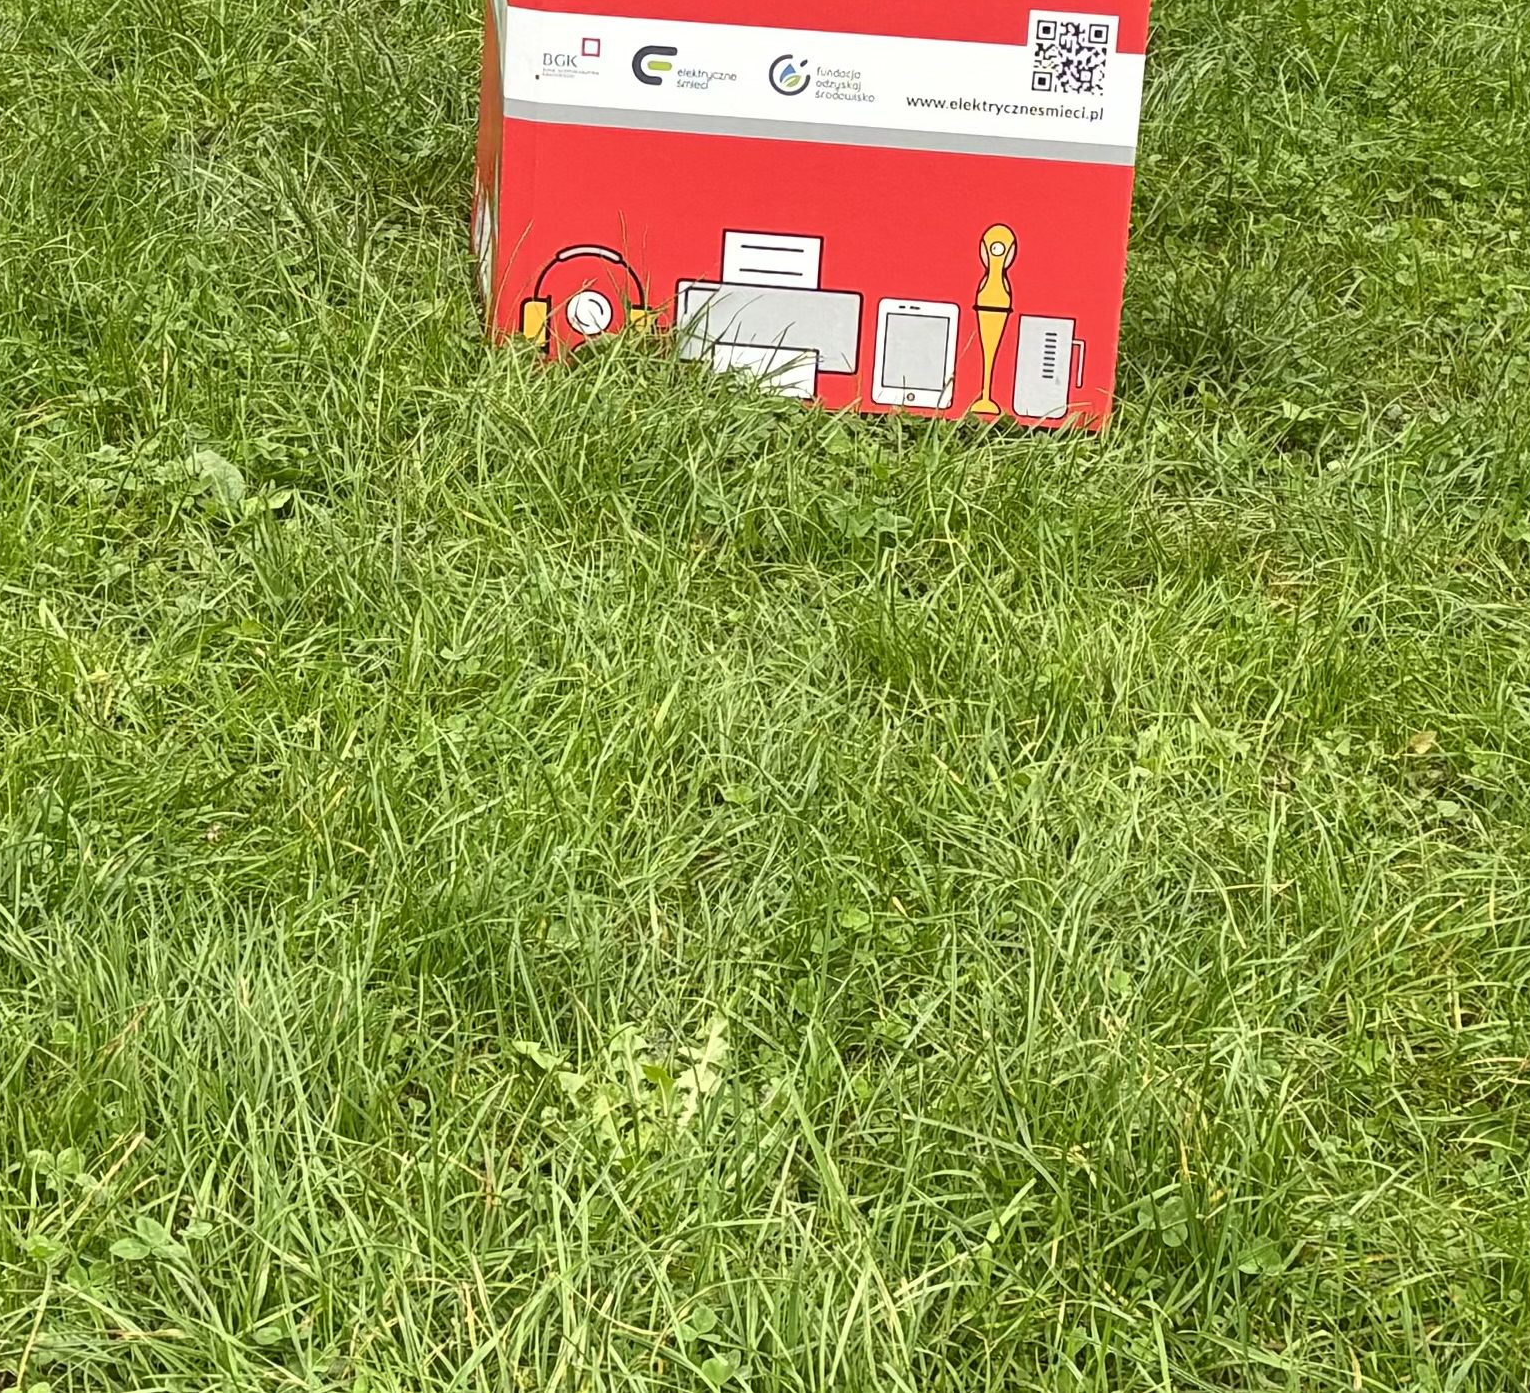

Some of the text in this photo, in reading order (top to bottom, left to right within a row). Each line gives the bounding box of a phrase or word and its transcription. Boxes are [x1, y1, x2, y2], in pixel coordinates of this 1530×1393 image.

[542, 52, 578, 68] BGK
[816, 66, 861, 81] fundacja
[815, 79, 861, 92] odzyskaj
[906, 96, 1104, 122] www.elektrycznesmieci.pl
